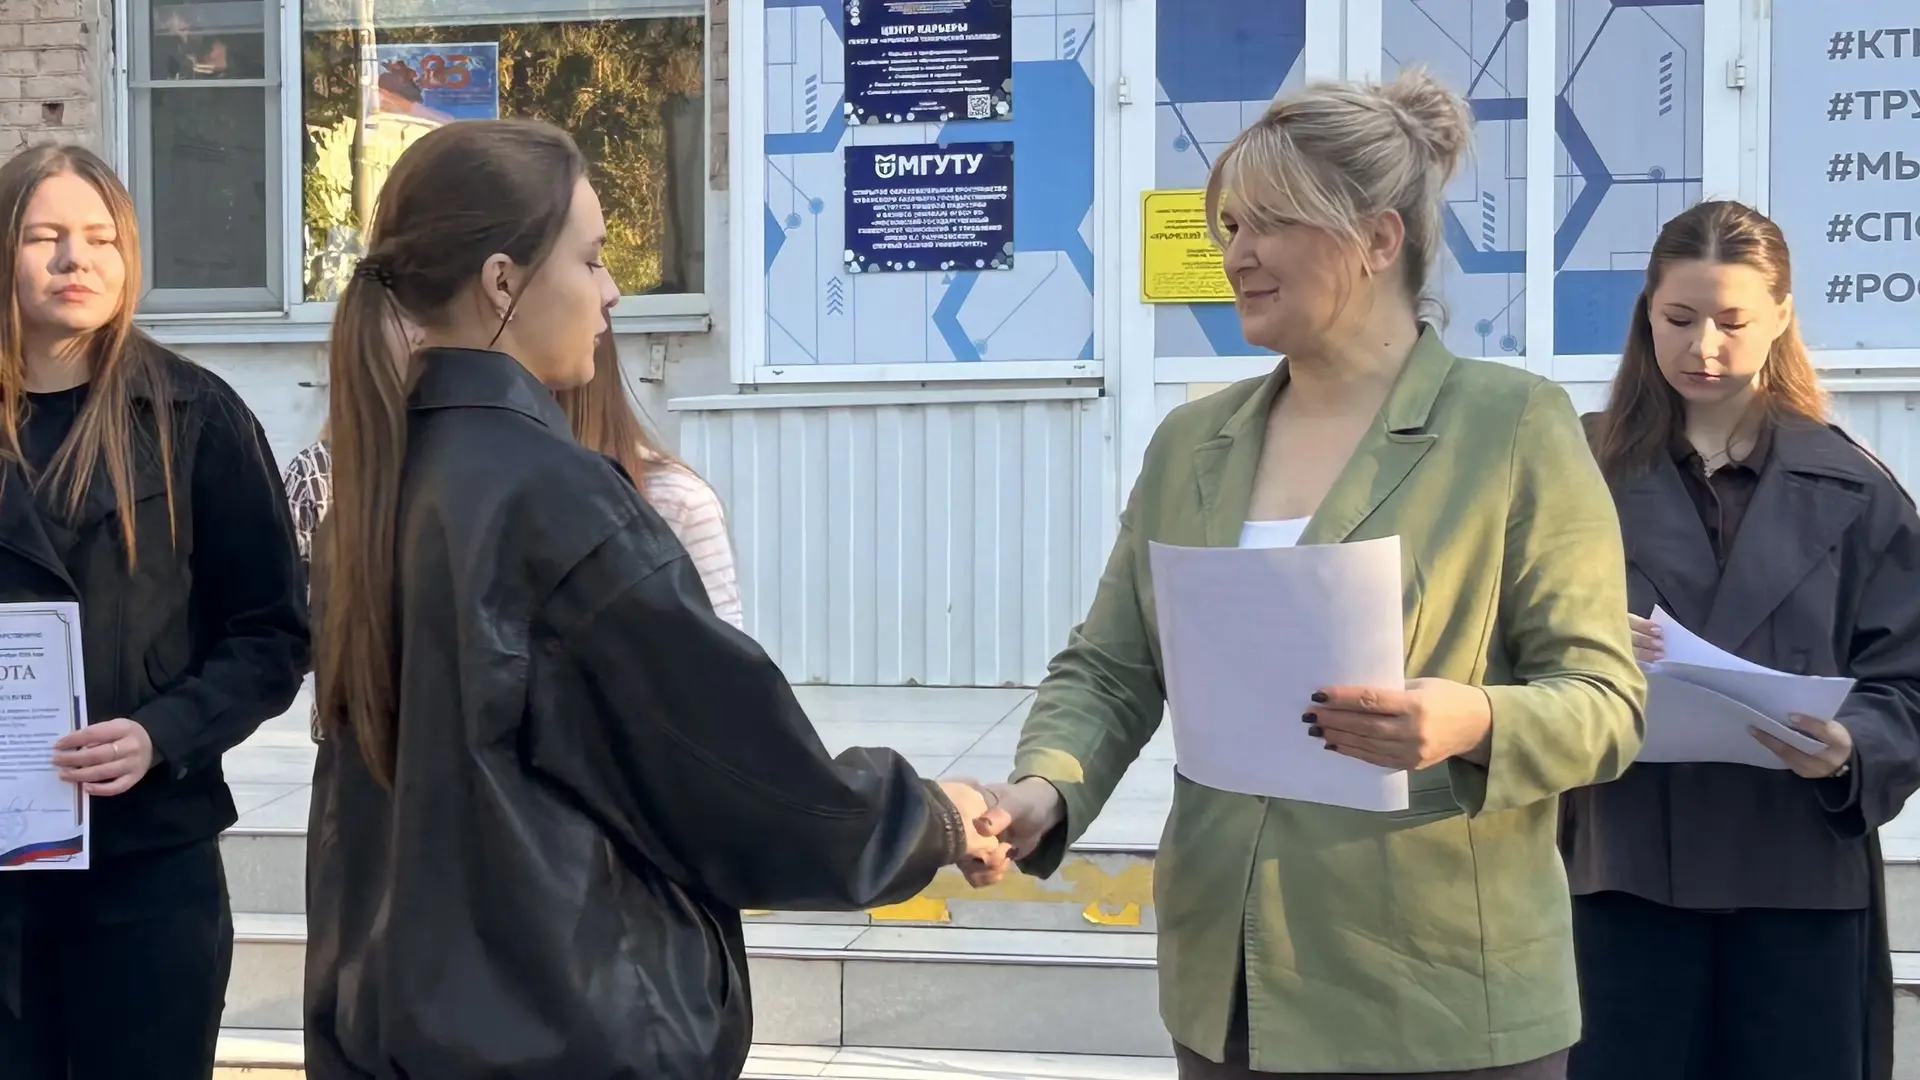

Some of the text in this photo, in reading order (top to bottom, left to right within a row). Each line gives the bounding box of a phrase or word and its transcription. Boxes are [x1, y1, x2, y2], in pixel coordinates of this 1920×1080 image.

[1827, 28, 1920, 60] #КТ
[898, 153, 984, 176] МГУТУ
[1826, 211, 1920, 243] #СП
[1825, 272, 1920, 304] #РО
